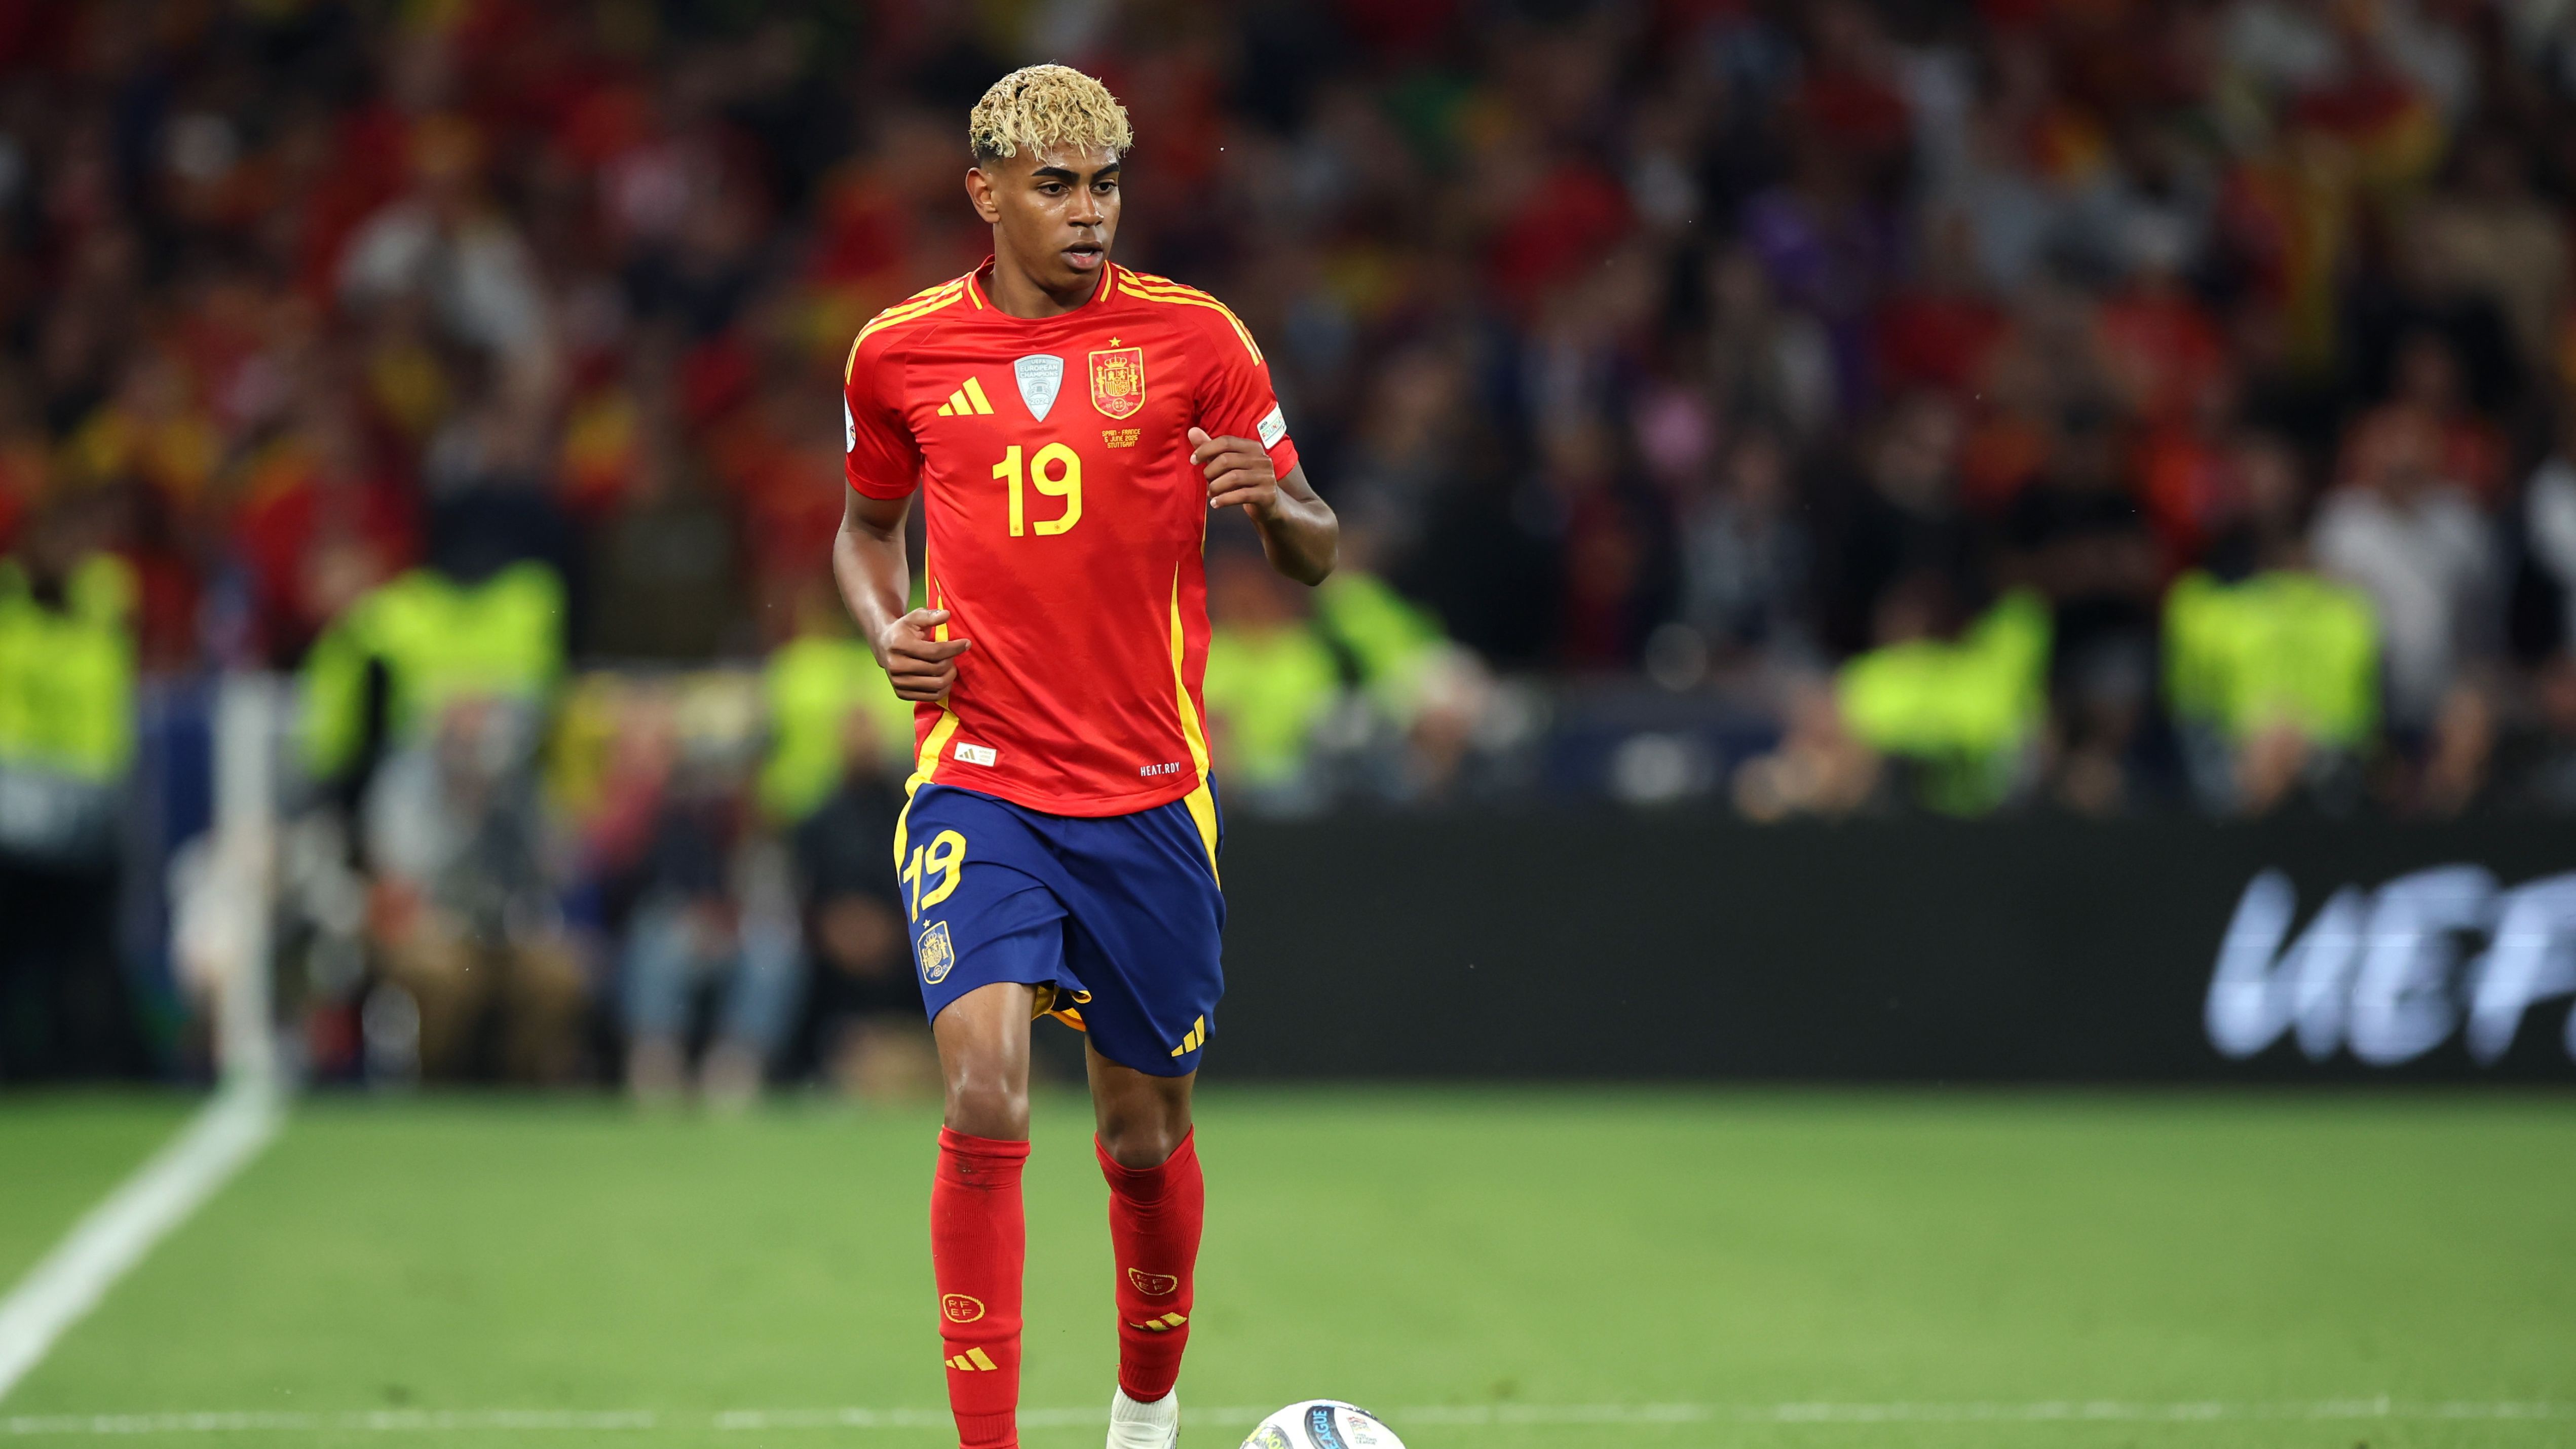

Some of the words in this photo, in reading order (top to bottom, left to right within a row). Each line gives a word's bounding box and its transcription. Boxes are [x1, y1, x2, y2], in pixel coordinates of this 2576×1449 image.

[1107, 441, 1135, 449] STUTTGART
[992, 442, 1082, 537] 19
[1140, 761, 1180, 777] HEAT.RDY
[903, 829, 967, 924] 19
[2202, 861, 2576, 1066] UEF
[1313, 1410, 1341, 1449] EAGUE
